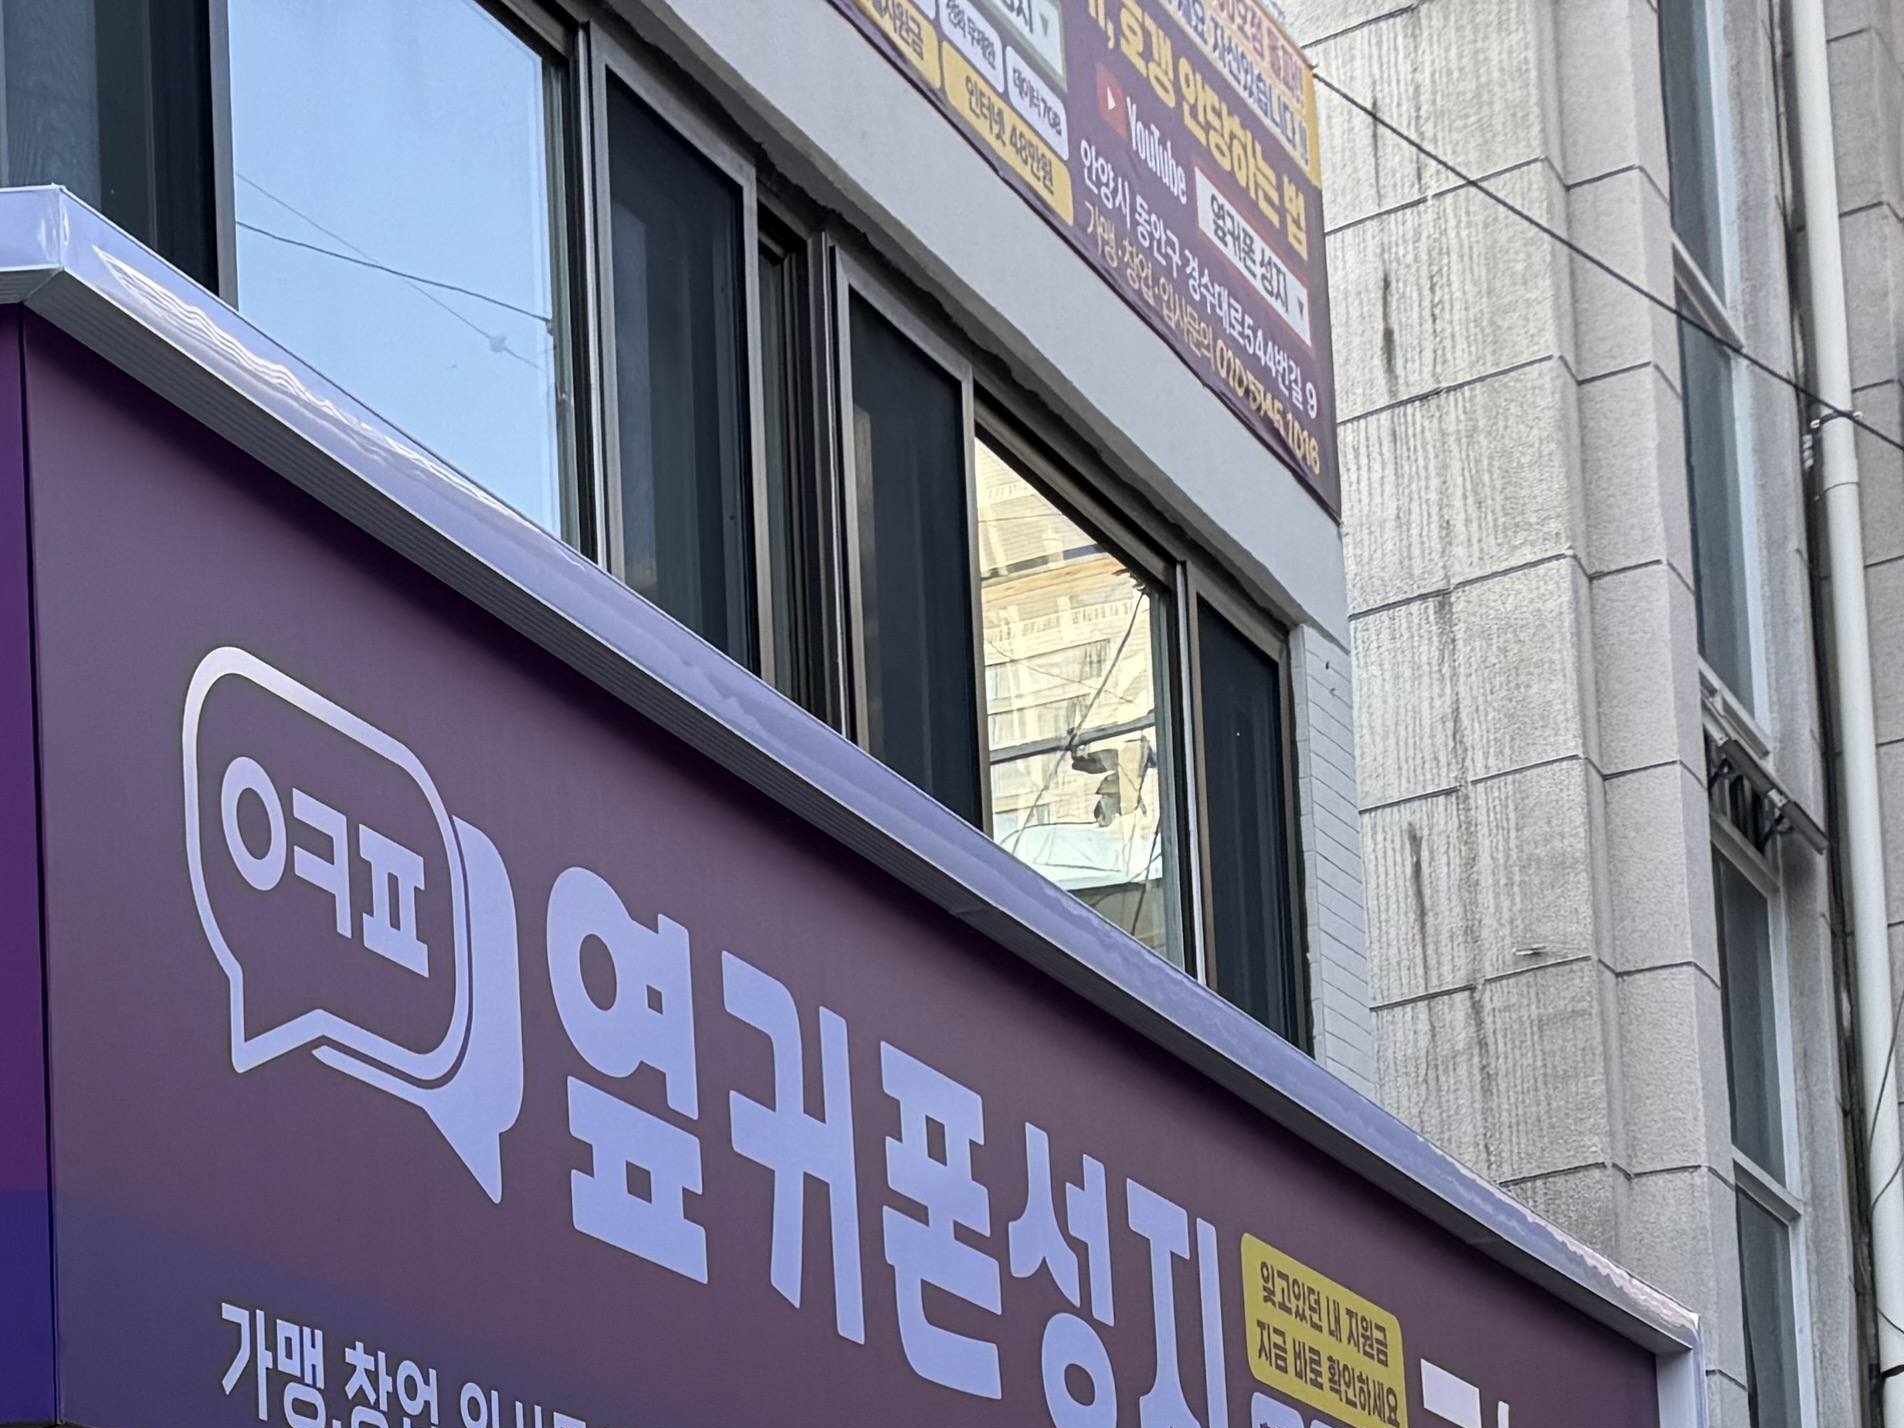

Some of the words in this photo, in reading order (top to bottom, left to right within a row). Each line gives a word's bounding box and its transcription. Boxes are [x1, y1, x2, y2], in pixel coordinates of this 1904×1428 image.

[1126, 97, 1187, 204] YouTube
[1180, 57, 1280, 228] 안당하는
[1284, 175, 1306, 259] 법
[1080, 140, 1131, 230] 안양시
[1135, 194, 1181, 278] 동안구
[1186, 249, 1303, 411] 경수대로544번길
[1260, 1261, 1322, 1334] 잊고있던
[1326, 1296, 1342, 1344] 내
[1346, 1305, 1388, 1368] 지원금
[1257, 1319, 1288, 1377] 지금
[1293, 1336, 1324, 1392] 바로
[1327, 1354, 1400, 1428] 확인하세요
